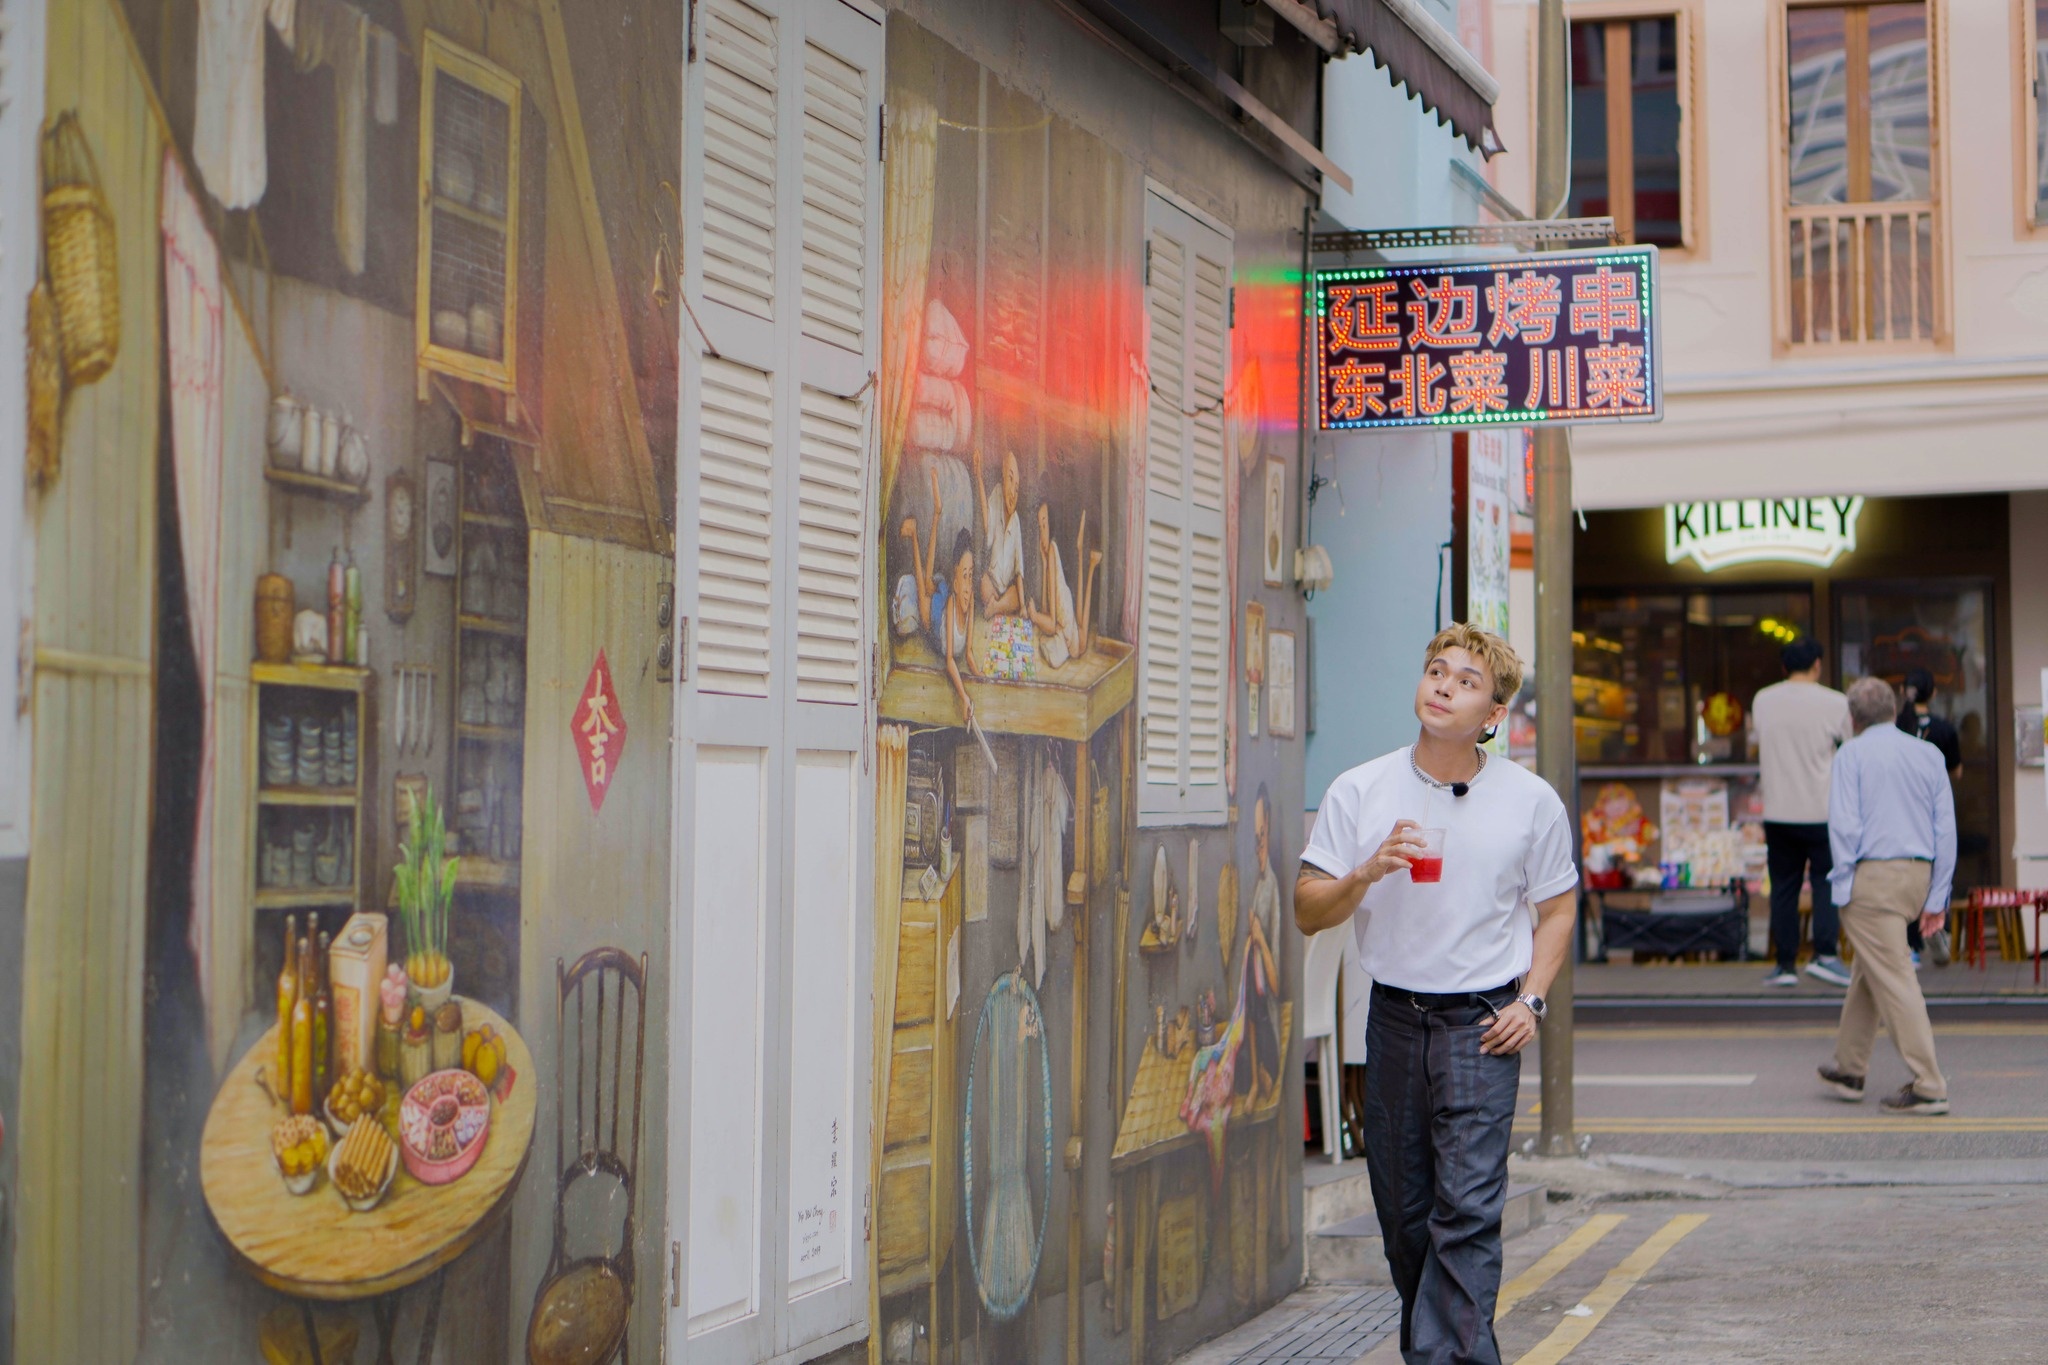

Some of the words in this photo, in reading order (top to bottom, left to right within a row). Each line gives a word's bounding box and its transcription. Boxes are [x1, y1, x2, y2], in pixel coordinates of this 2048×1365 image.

[1327, 265, 1641, 355] 延边烤串
[1327, 349, 1509, 419] 东北菜
[1525, 342, 1646, 410] 川菜
[1674, 497, 1853, 546] KILLINEY
